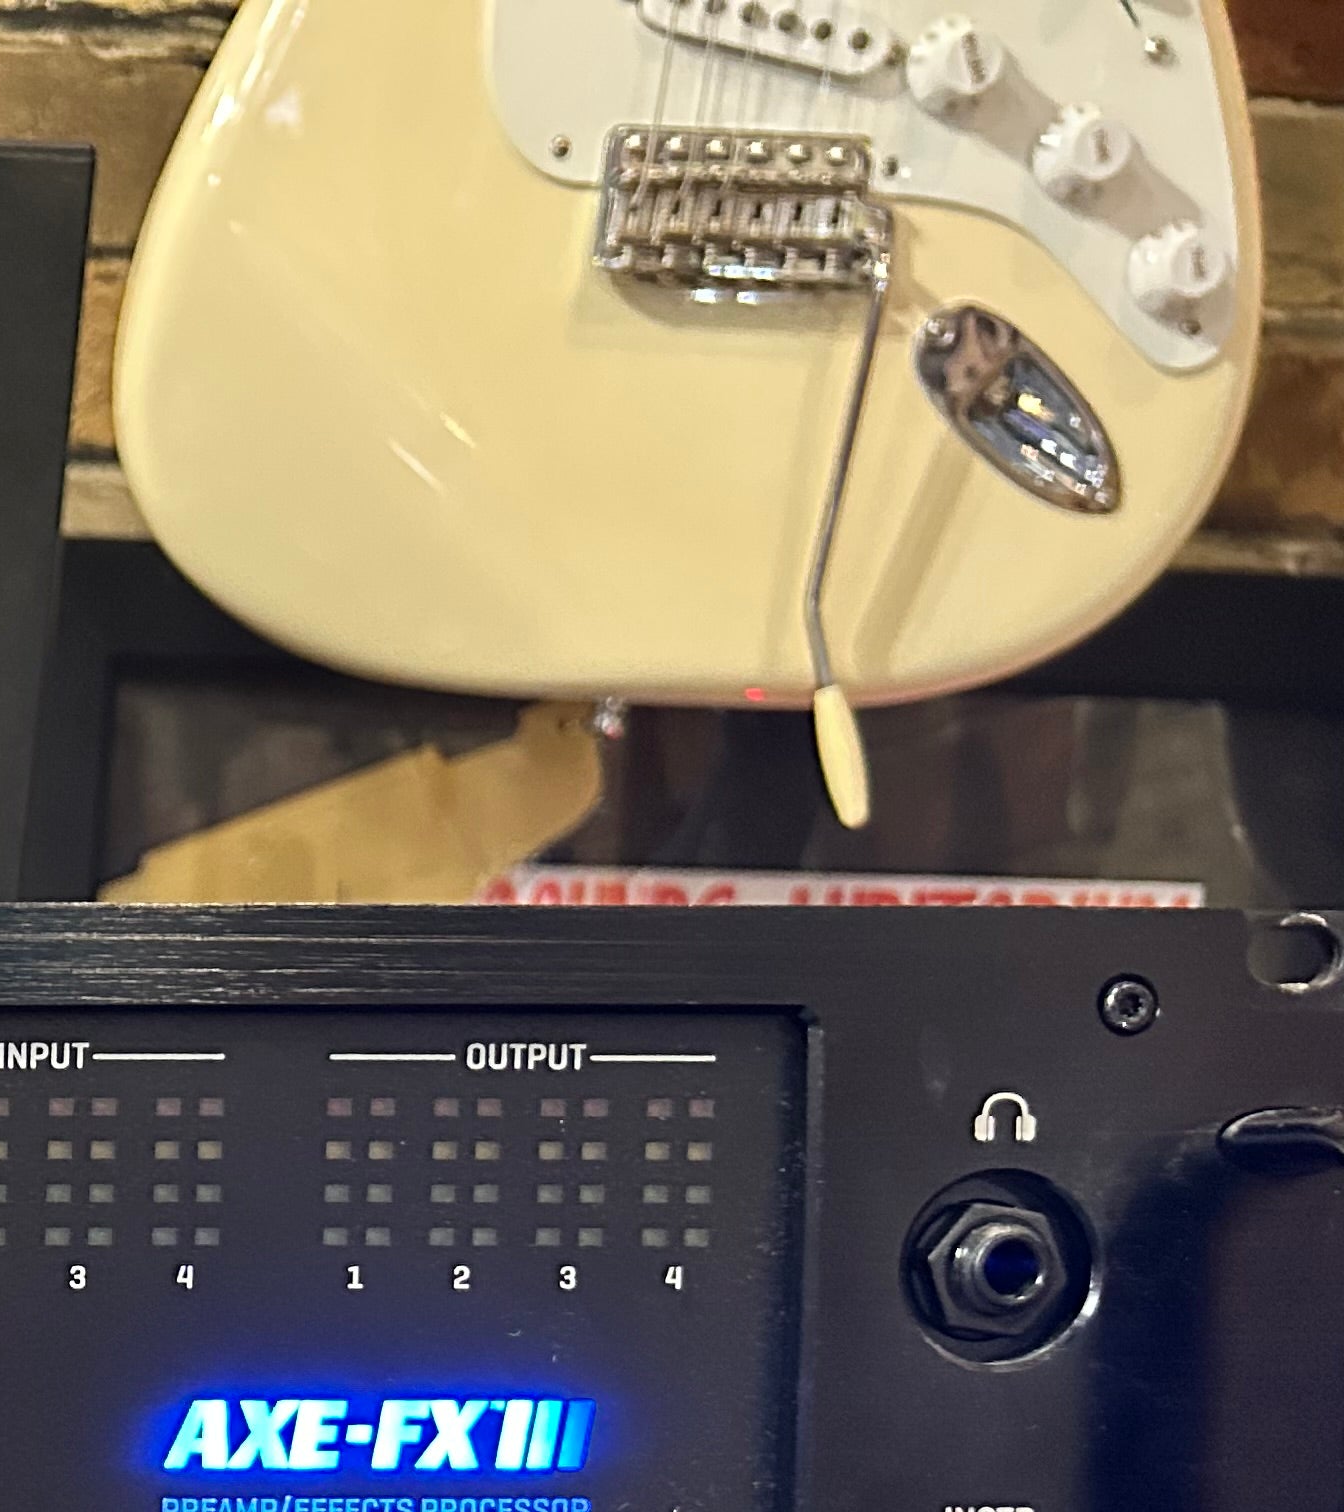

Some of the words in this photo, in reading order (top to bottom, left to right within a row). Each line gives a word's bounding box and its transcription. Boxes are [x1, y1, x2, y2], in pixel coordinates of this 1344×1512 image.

[466, 1042, 587, 1071] OUTPUT
[69, 1265, 86, 1290] 3
[176, 1265, 194, 1290] 4
[347, 1265, 364, 1290] 1
[453, 1265, 471, 1290] 2
[559, 1265, 577, 1290] 3
[664, 1265, 683, 1290] 4
